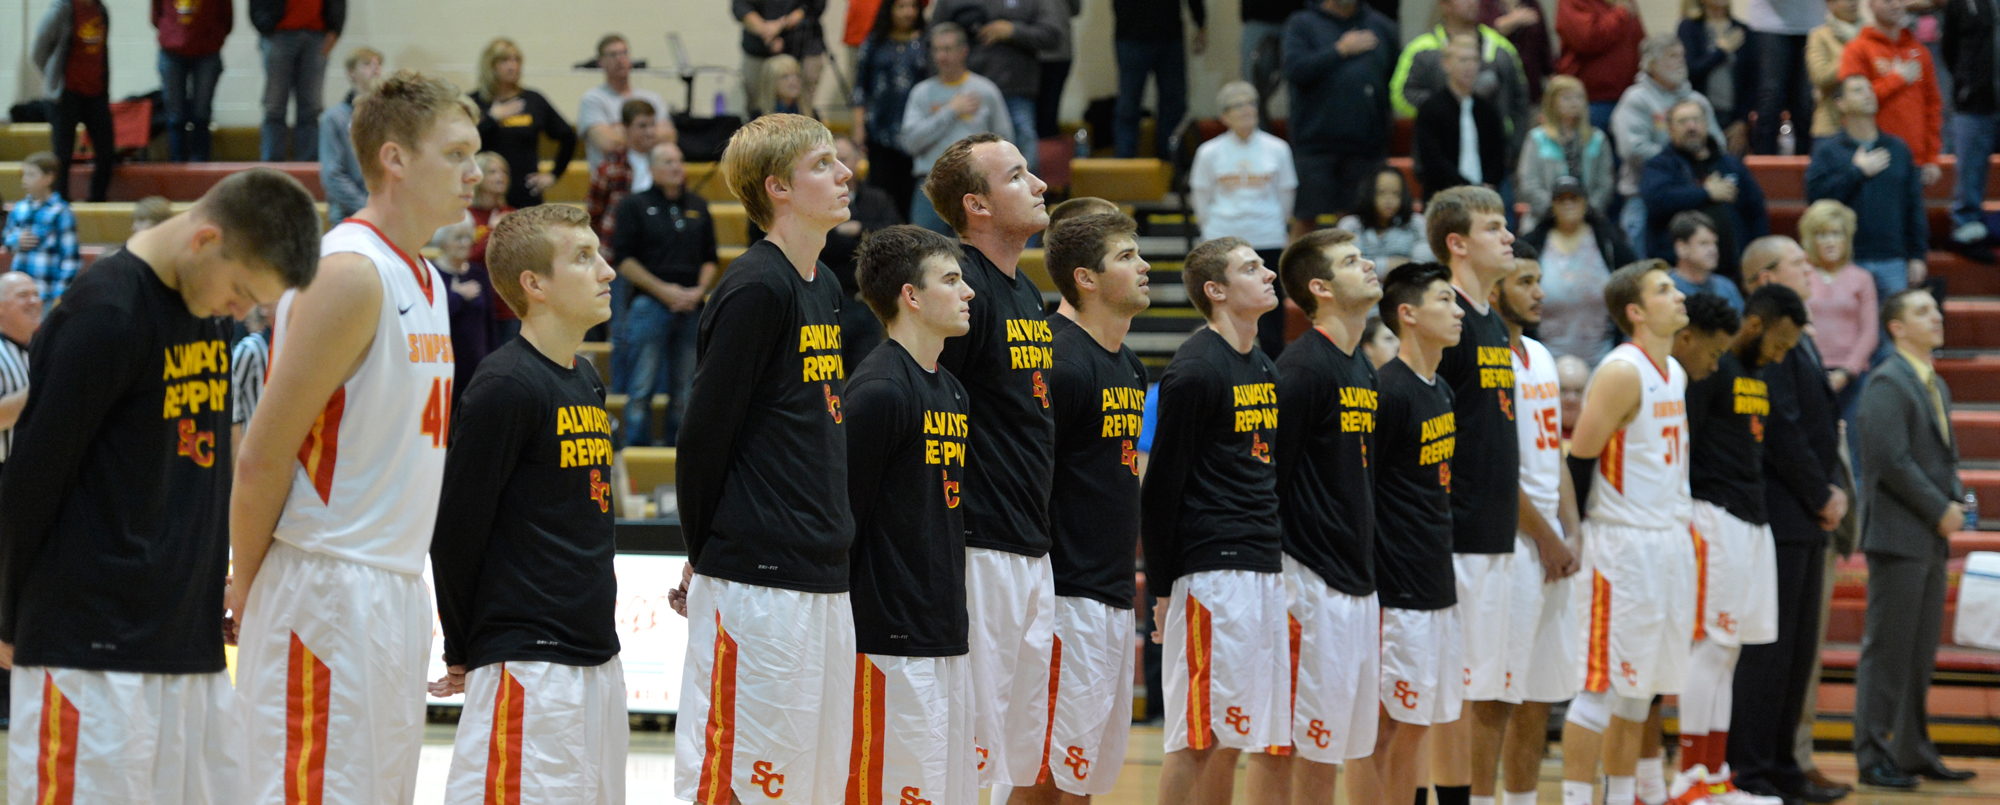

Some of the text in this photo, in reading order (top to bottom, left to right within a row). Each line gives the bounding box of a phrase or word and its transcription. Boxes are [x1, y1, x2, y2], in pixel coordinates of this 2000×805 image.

[1233, 383, 1277, 407] ALWAYS
[178, 418, 215, 468] SC
[590, 469, 610, 513] SC
[1393, 680, 1418, 709] SC
[1225, 706, 1250, 736] SC
[1307, 718, 1331, 750] SC
[751, 760, 785, 799] SC
[1064, 745, 1090, 781] SC
